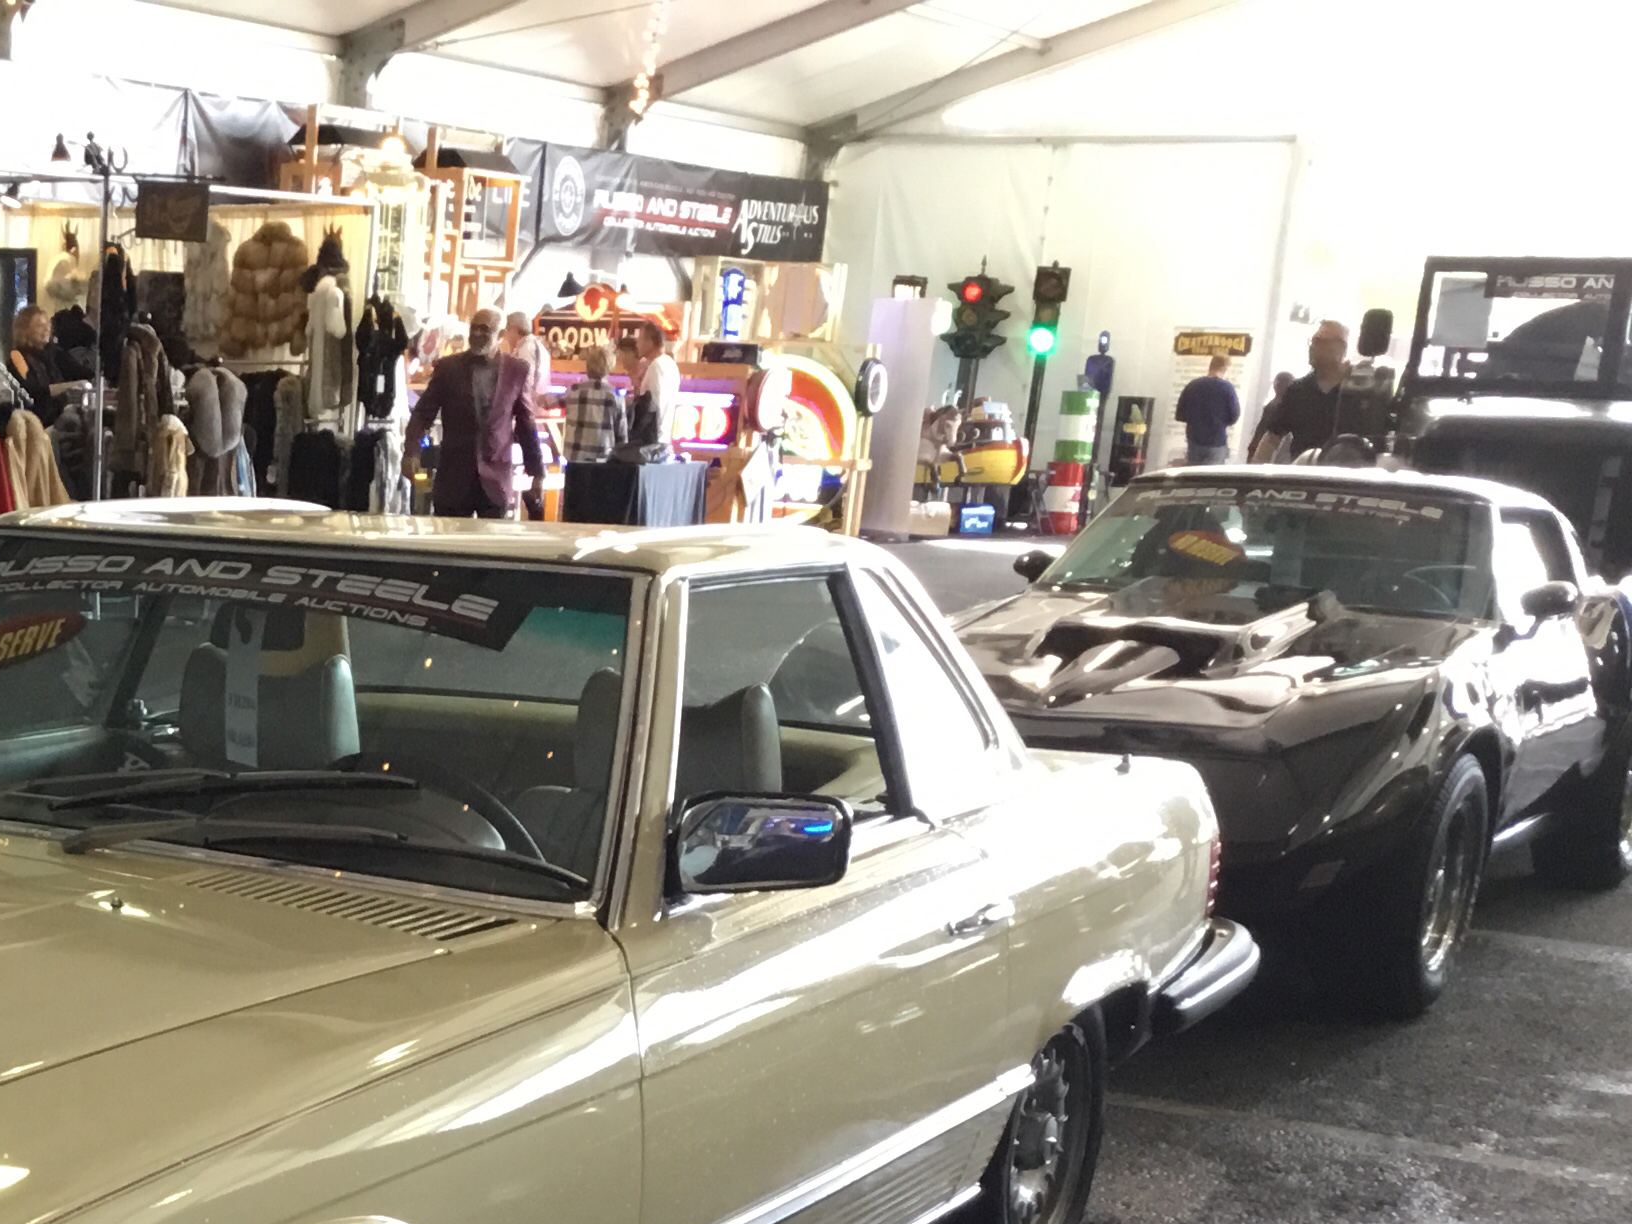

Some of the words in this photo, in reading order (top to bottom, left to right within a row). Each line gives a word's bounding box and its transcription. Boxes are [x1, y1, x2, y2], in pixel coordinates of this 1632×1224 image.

[646, 196, 678, 217] AND
[741, 221, 783, 255] STILLS
[1496, 275, 1576, 289] RUSSO
[1582, 276, 1615, 289] AN
[1136, 486, 1237, 502] RUSSO
[1245, 488, 1307, 501] AND
[1315, 492, 1444, 521] STEELE
[134, 581, 288, 604] AUTOMOBILE
[293, 595, 430, 628] AUCTIONS
[141, 561, 251, 581] AND
[260, 565, 500, 622] STEELE
